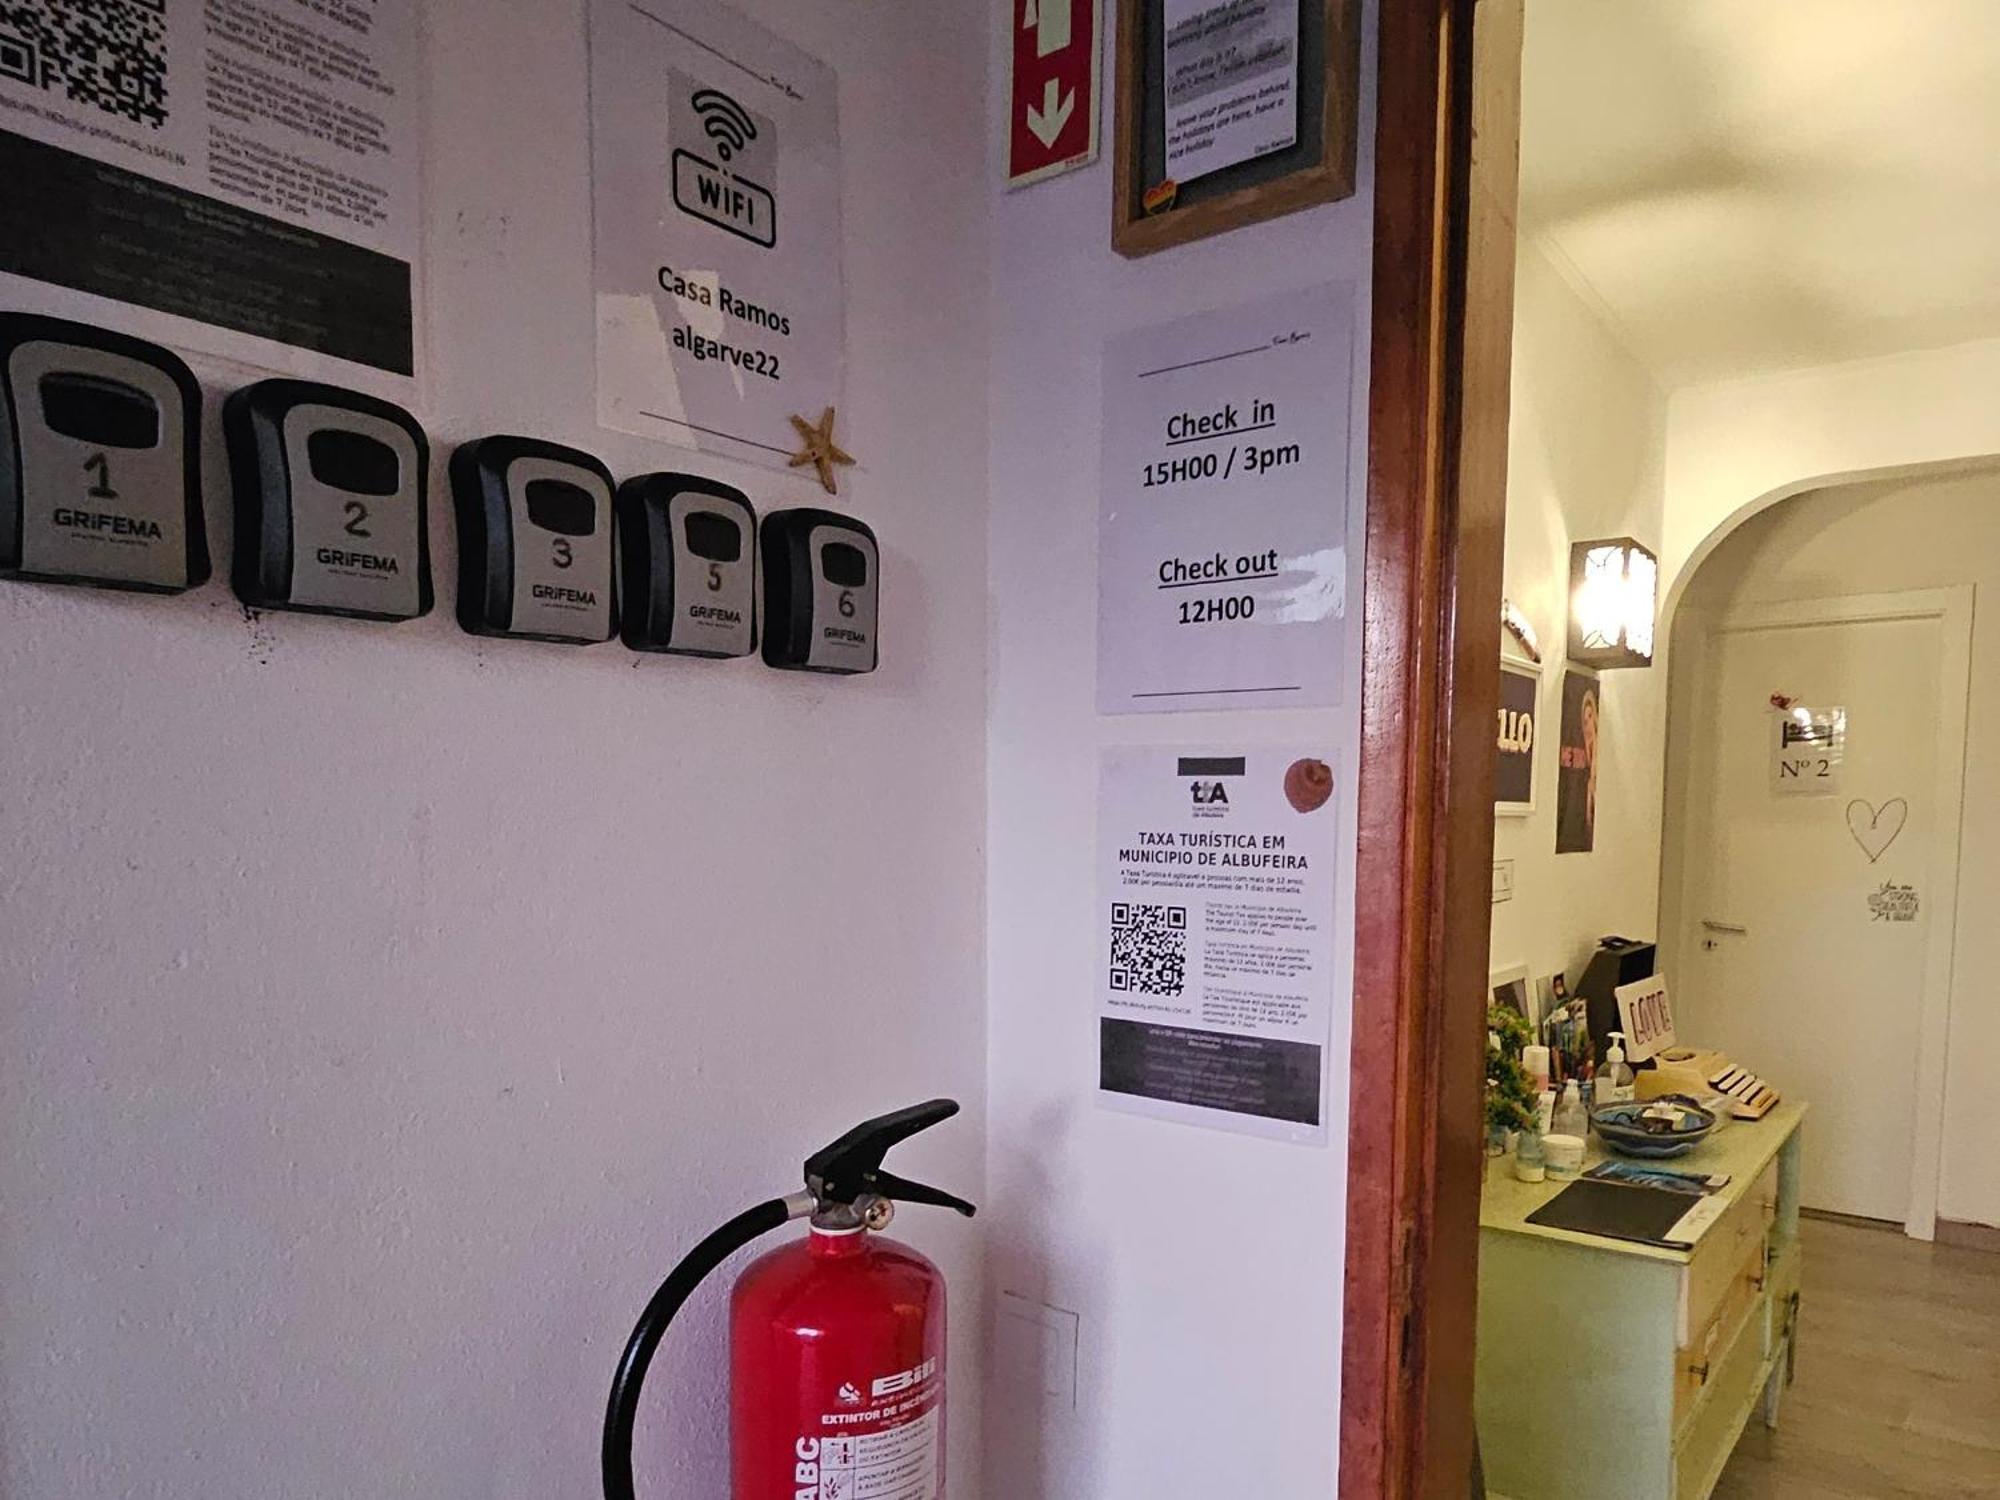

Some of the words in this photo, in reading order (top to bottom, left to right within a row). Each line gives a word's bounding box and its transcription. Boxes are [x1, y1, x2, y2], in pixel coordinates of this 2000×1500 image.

[657, 265, 713, 307] Casa
[718, 287, 791, 336] Ramos
[672, 324, 780, 380] algarve22
[1167, 404, 1238, 440] Check
[1253, 399, 1275, 425] in
[83, 451, 119, 499] 1
[1143, 453, 1218, 487] 15H00
[1223, 447, 1237, 480] /
[1243, 443, 1300, 475] 3pm
[343, 500, 372, 538] 2
[552, 537, 573, 569] 3
[1159, 553, 1229, 583] Check
[1235, 549, 1279, 574] out
[706, 563, 722, 592] 5
[838, 590, 856, 618] 6
[1178, 595, 1255, 624] 12H00
[1817, 759, 1830, 777] 2
[1138, 831, 1175, 846] TAXA
[1178, 830, 1257, 849] TURÍSTICA
[1262, 835, 1285, 850] EM
[1198, 852, 1217, 866] DE
[1221, 853, 1308, 869] ALBUFEIRA
[821, 1410, 881, 1425] EXTINTOR
[883, 1404, 898, 1418] DE
